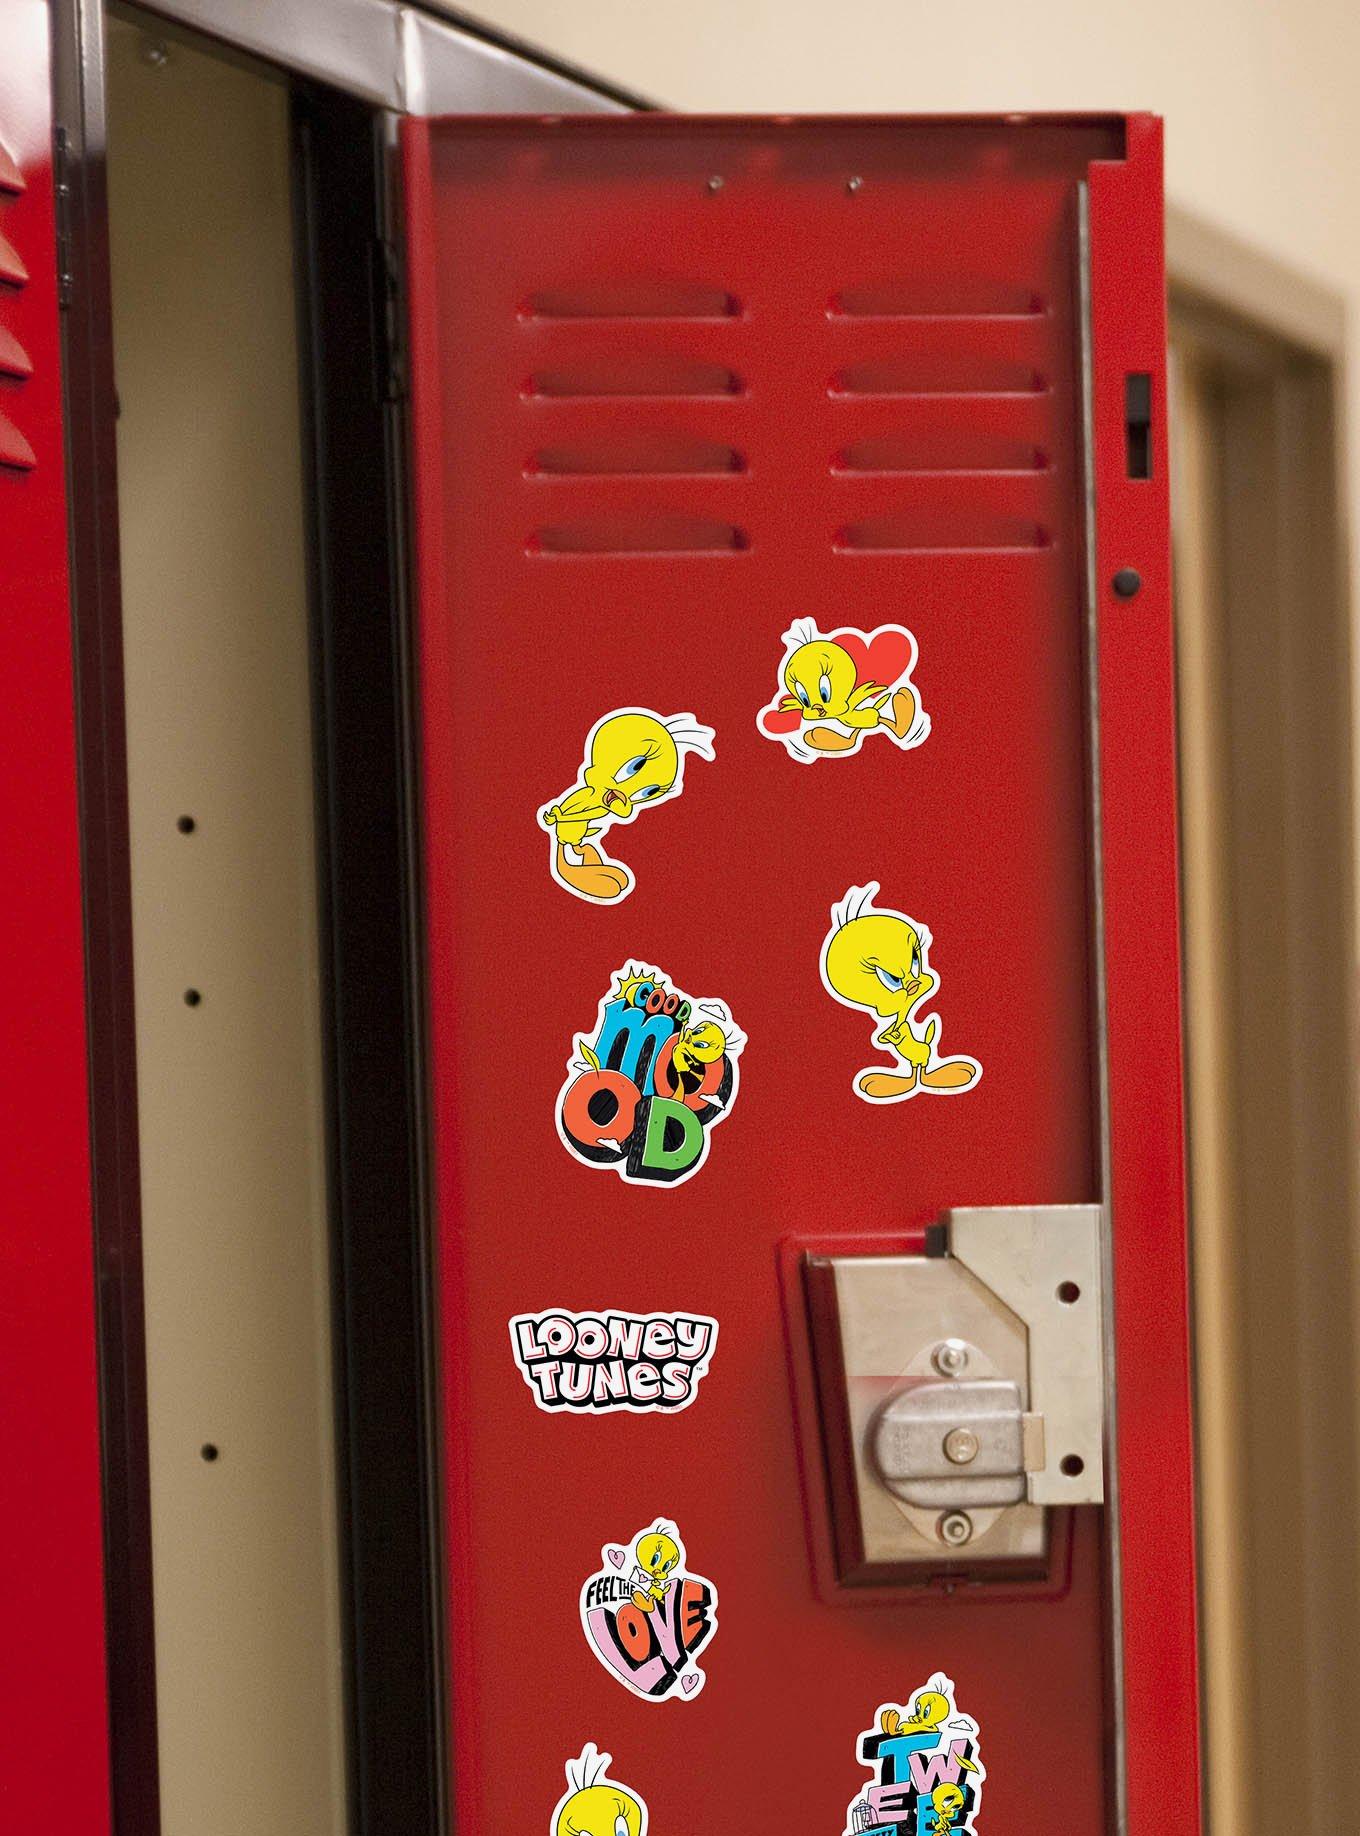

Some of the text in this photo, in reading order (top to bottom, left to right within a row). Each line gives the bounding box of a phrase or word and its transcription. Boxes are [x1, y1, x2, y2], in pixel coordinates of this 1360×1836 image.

[634, 981, 692, 1021] GOOD
[586, 1576, 636, 1608] FEEL THE
[587, 1578, 711, 1696] LOVE
